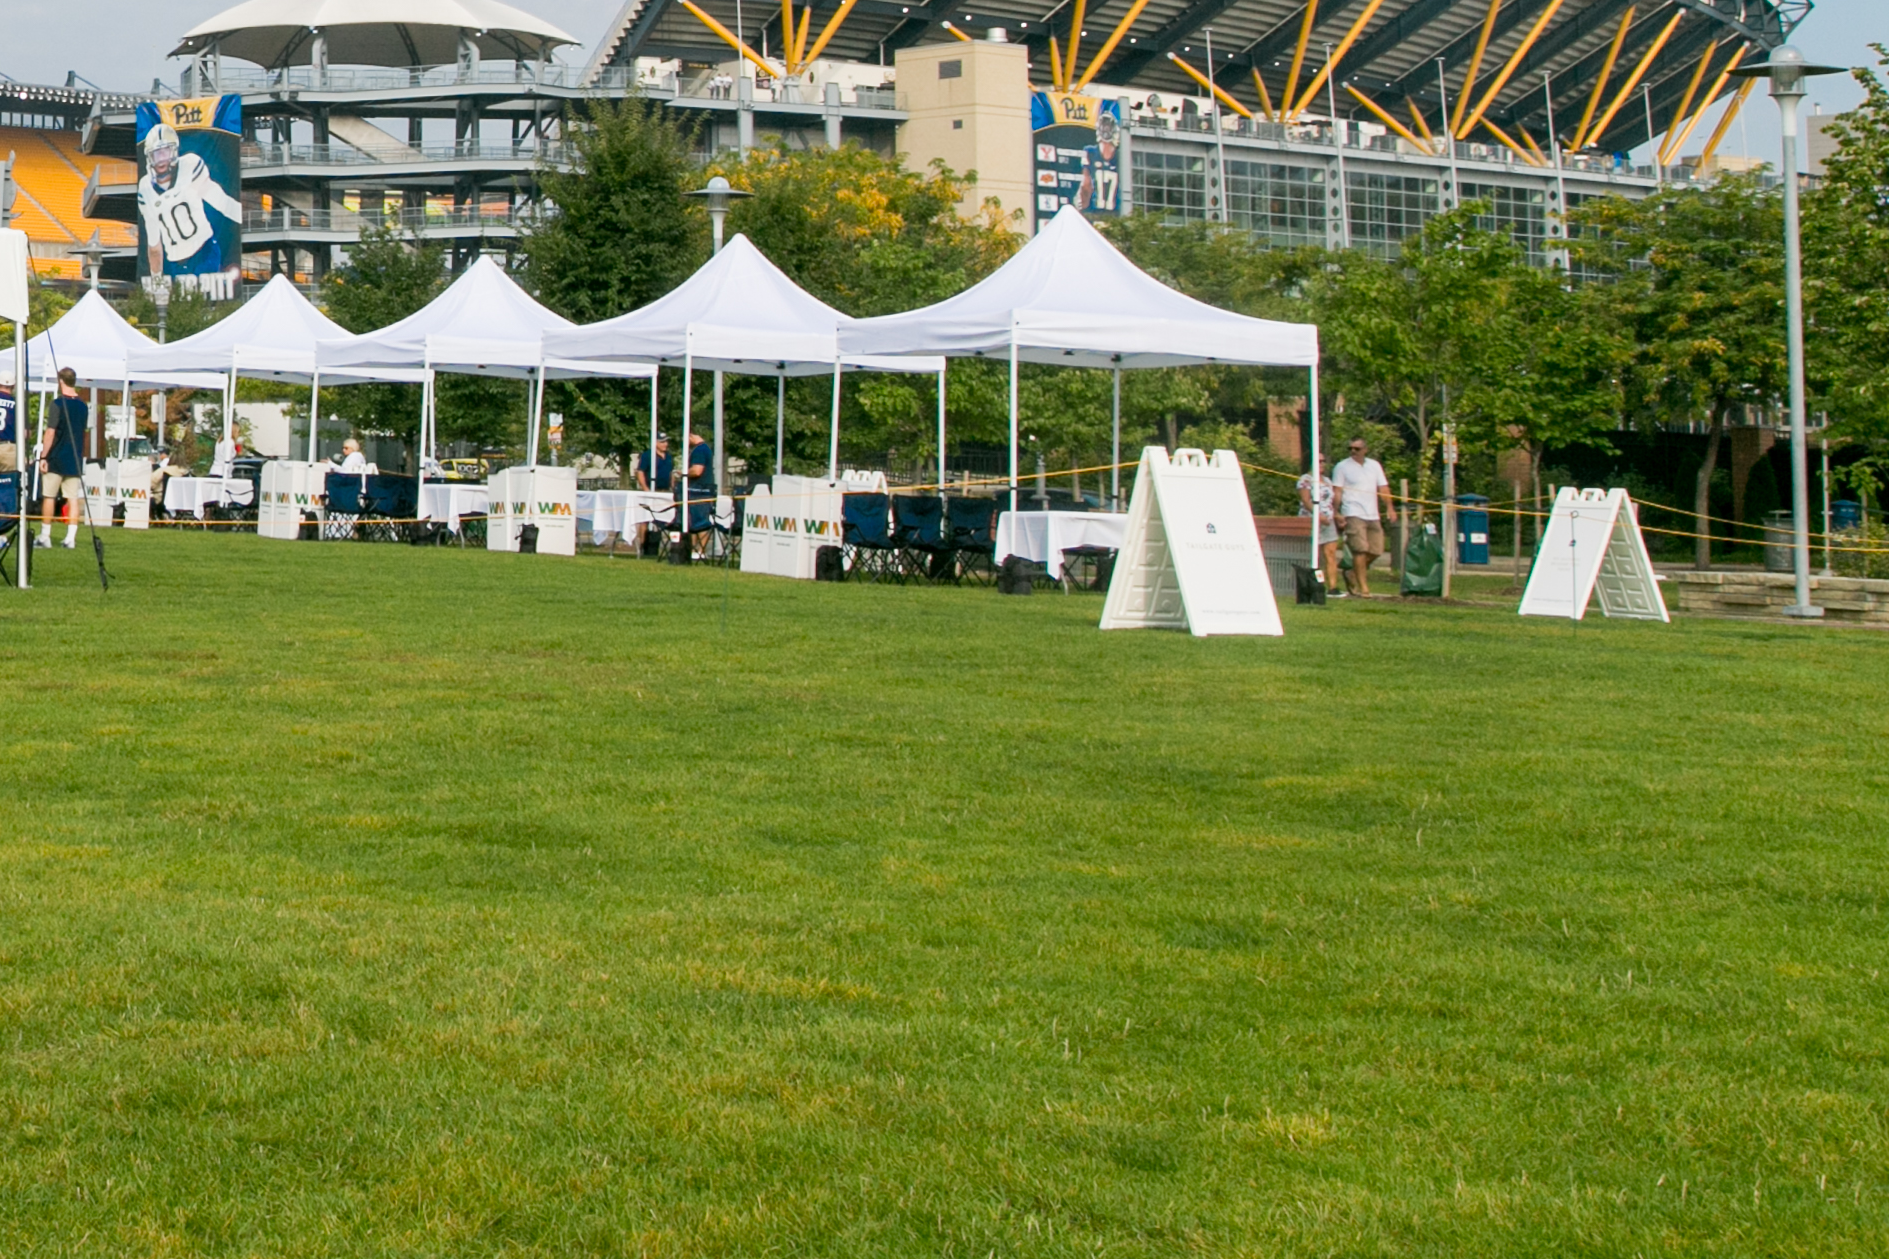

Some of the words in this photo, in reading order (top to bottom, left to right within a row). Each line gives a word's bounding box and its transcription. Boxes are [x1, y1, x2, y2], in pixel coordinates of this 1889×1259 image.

[172, 103, 203, 125] Pitt
[1061, 97, 1089, 121] Pitt
[1095, 169, 1118, 211] 17
[159, 201, 198, 246] 10
[199, 271, 236, 301] PITT
[121, 488, 148, 499] WM
[538, 501, 572, 515] WM
[746, 513, 769, 530] WM
[773, 516, 797, 532] WM
[804, 518, 840, 537] WM
[1185, 542, 1223, 551] TAILGATE
[1225, 543, 1245, 551] GUYS
